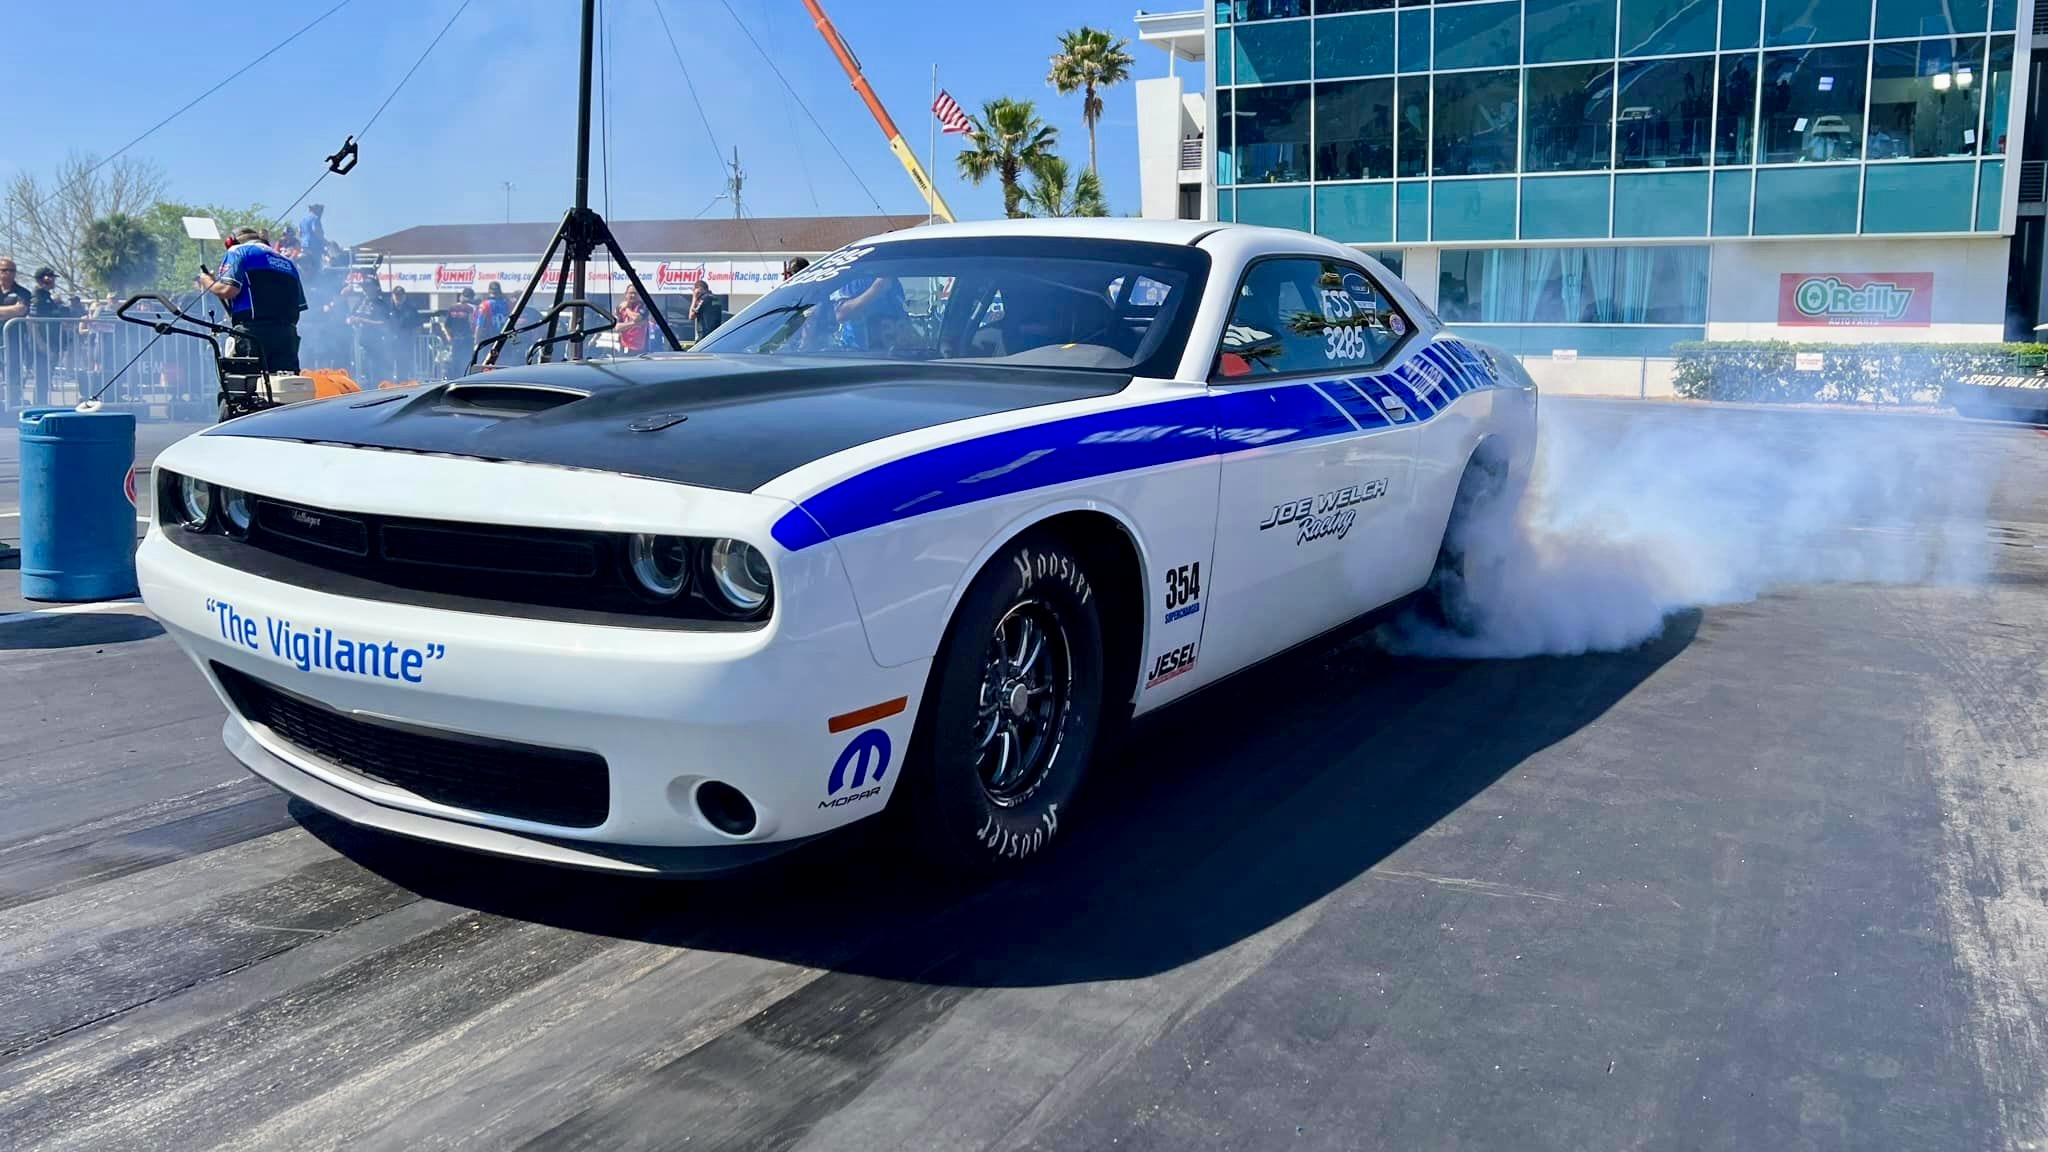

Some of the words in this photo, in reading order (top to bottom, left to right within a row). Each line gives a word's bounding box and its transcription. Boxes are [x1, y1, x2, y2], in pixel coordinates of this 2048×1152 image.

[435, 264, 476, 289] SUMMIT
[657, 261, 704, 290] SUMMIT
[707, 271, 779, 283] SummitRacing.com
[1320, 289, 1353, 323] FSS
[1797, 276, 1909, 318] O'Reilly
[1322, 325, 1366, 360] 3285
[1965, 374, 2003, 386] SPEED
[2019, 377, 2045, 389] ALL
[1260, 496, 1313, 532] JOE
[1318, 477, 1389, 515] WELCH
[1296, 509, 1356, 546] Racing
[1165, 561, 1200, 610] 354
[1148, 642, 1196, 681] JESEL
[817, 786, 881, 809] MOPAR
